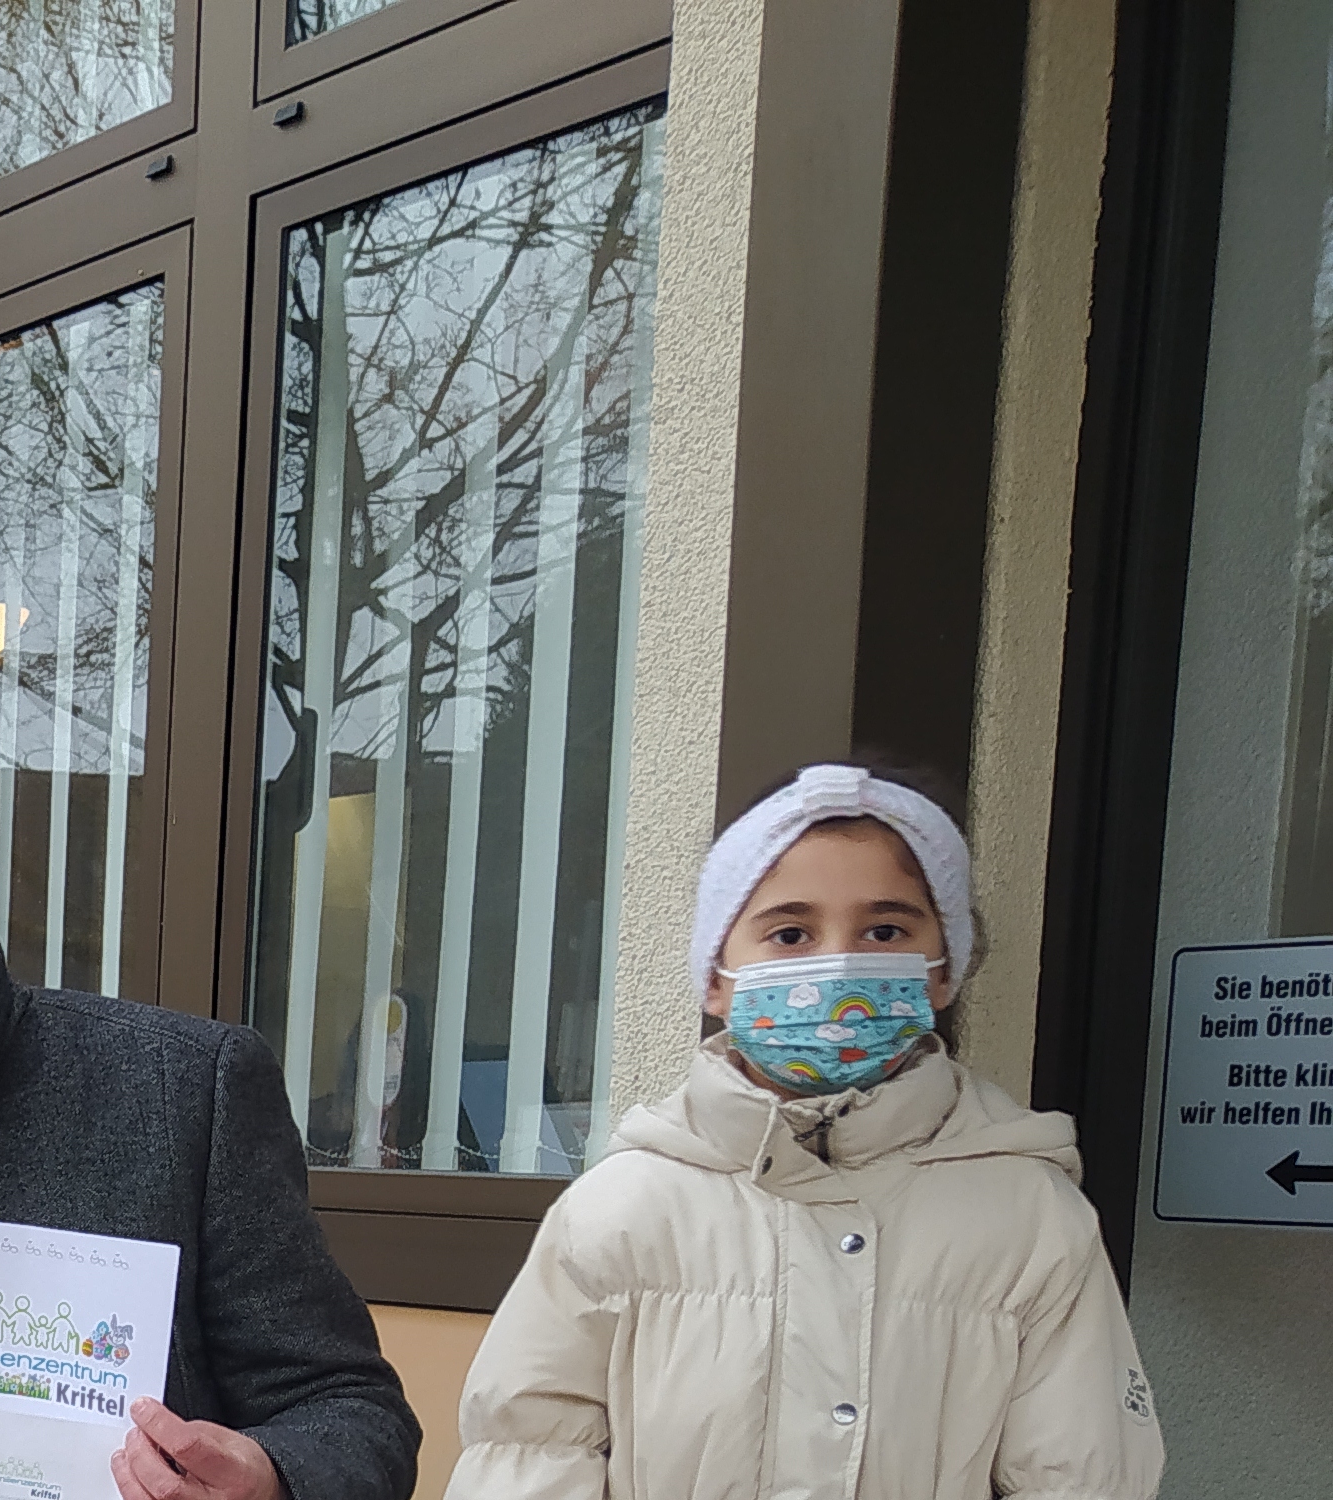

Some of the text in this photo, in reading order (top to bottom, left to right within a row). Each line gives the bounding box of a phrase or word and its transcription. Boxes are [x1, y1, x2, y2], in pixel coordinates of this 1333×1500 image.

[1214, 972, 1333, 1001] Sie benöt
[1199, 1005, 1333, 1038] beim Öffne
[1228, 1063, 1288, 1088] Bitte
[1180, 1100, 1217, 1125] wir
[1222, 1100, 1301, 1126] helfen
[55, 1381, 126, 1419] Kriftel
